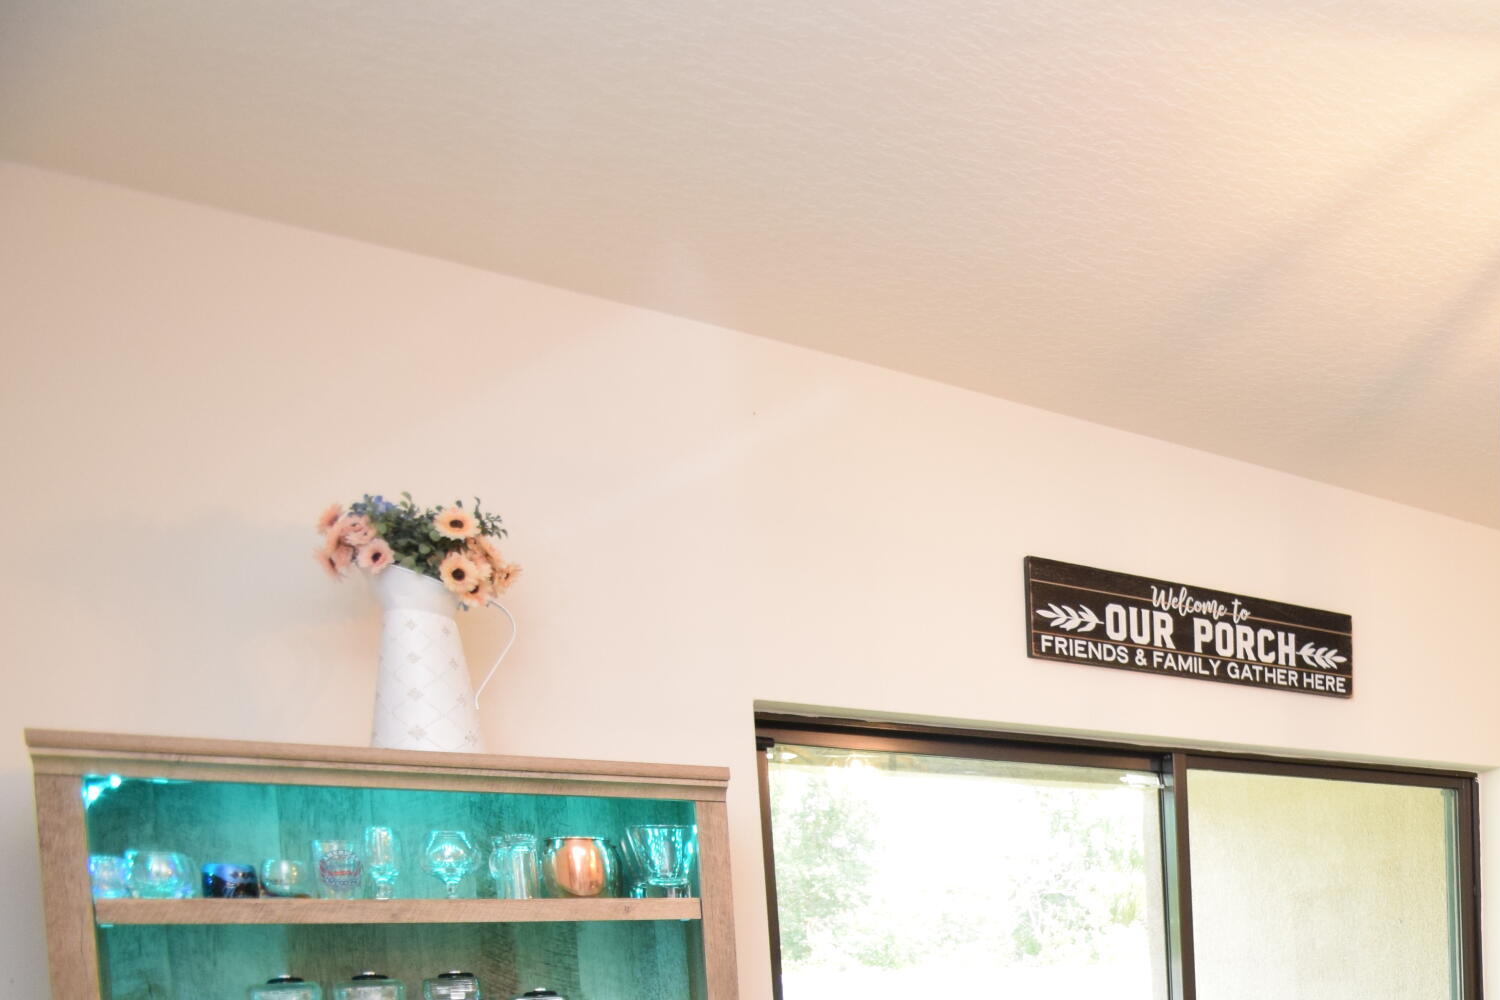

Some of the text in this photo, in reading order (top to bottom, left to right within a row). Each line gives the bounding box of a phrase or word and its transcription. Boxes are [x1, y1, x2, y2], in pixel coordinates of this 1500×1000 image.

[1150, 585, 1251, 624] Welcome to
[1040, 634, 1347, 693] FRIENDS & FAMILY GATHER HERE
[1105, 602, 1297, 667] OUR PORCH
